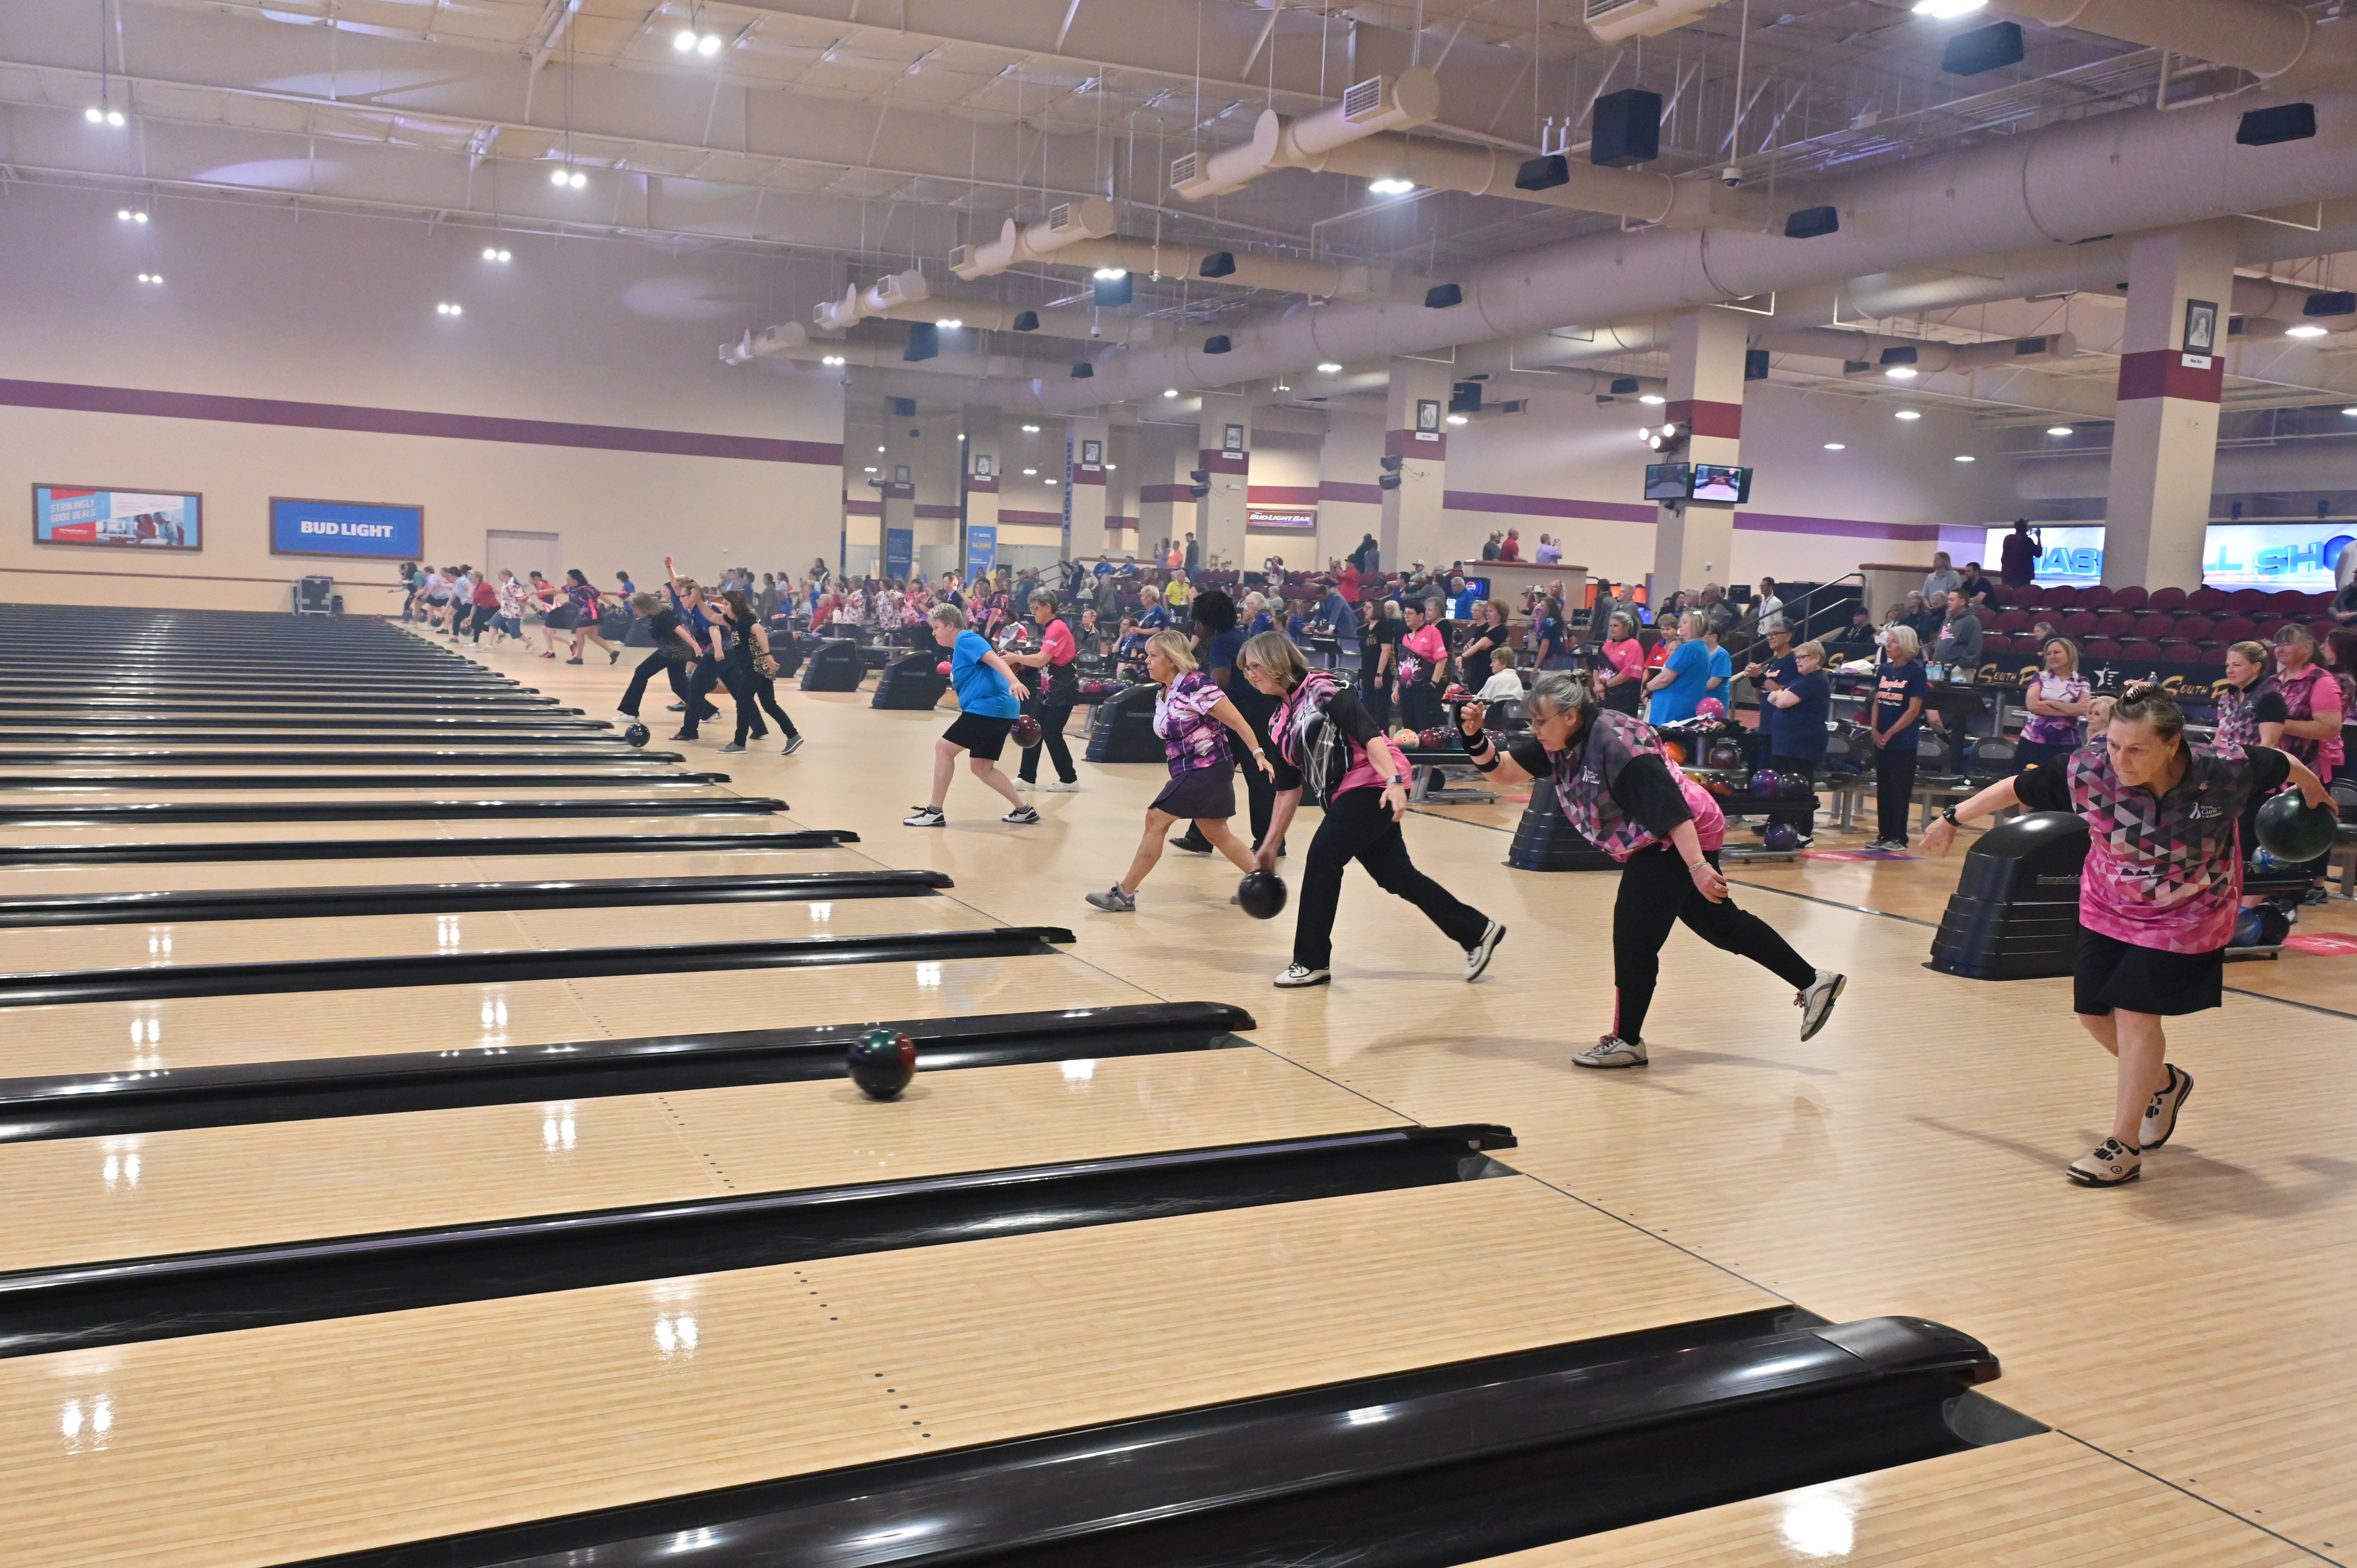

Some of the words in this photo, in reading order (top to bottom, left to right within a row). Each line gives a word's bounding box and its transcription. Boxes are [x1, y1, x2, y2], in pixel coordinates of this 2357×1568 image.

[50, 499, 95, 513] STRIKINGLY
[51, 512, 70, 522] GOOD
[73, 509, 95, 520] DEALS
[301, 521, 339, 534] BUD
[341, 523, 393, 537] LIGHT
[1978, 663, 2017, 683] SOUTH
[2162, 676, 2209, 696] SOUTH
